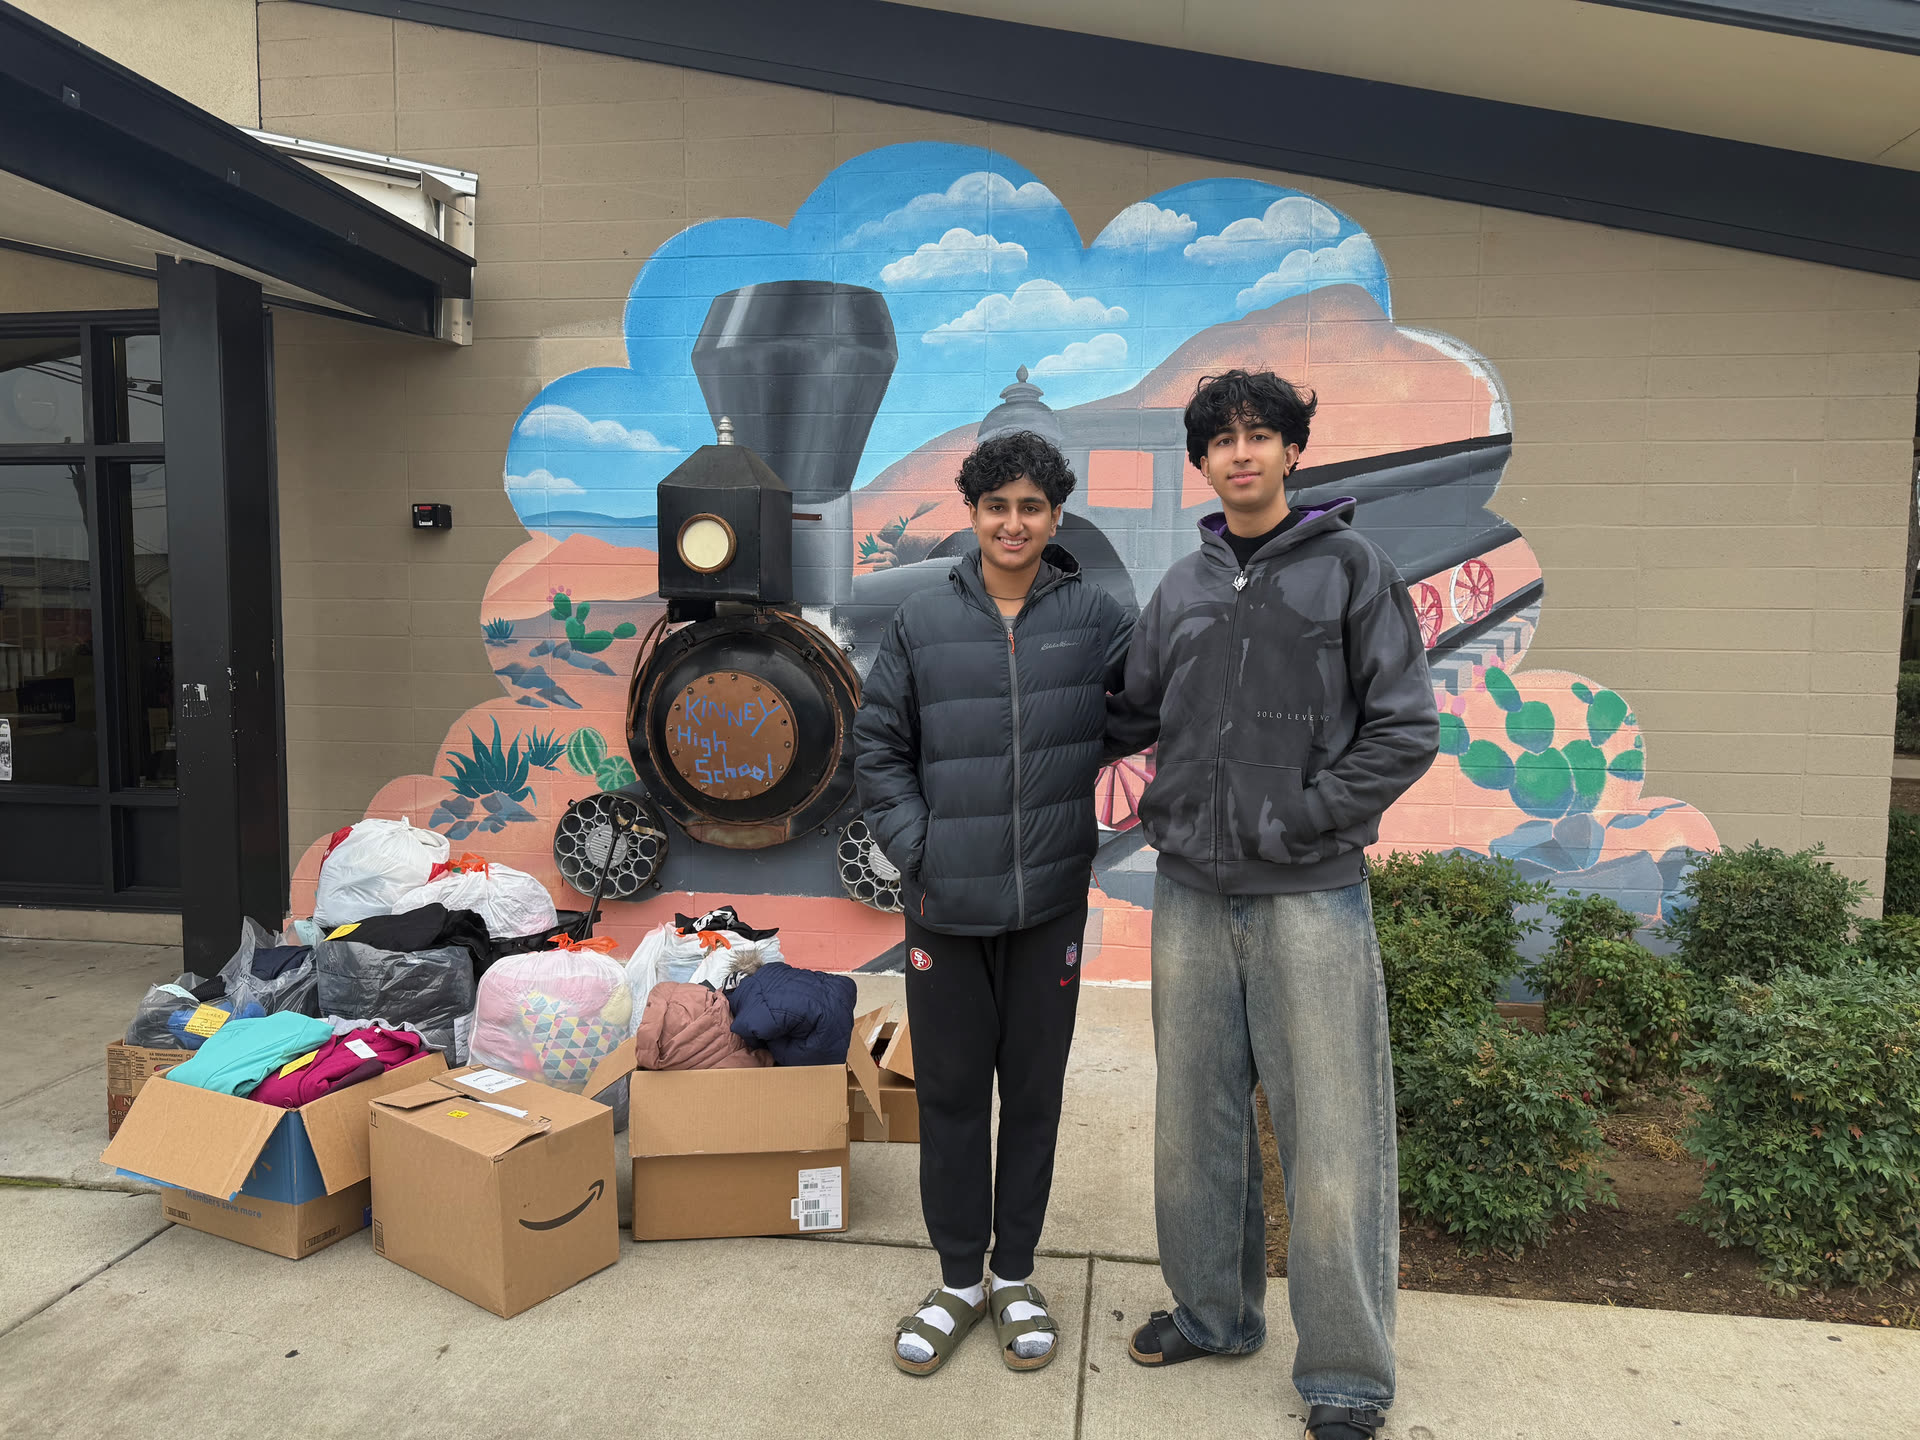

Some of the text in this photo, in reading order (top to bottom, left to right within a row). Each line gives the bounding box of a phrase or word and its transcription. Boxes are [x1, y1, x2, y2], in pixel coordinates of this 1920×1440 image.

[1256, 710, 1330, 722] SOLO LEVENG
[677, 725, 727, 757] High
[695, 754, 773, 784] School
[185, 1190, 262, 1218] Members save more
